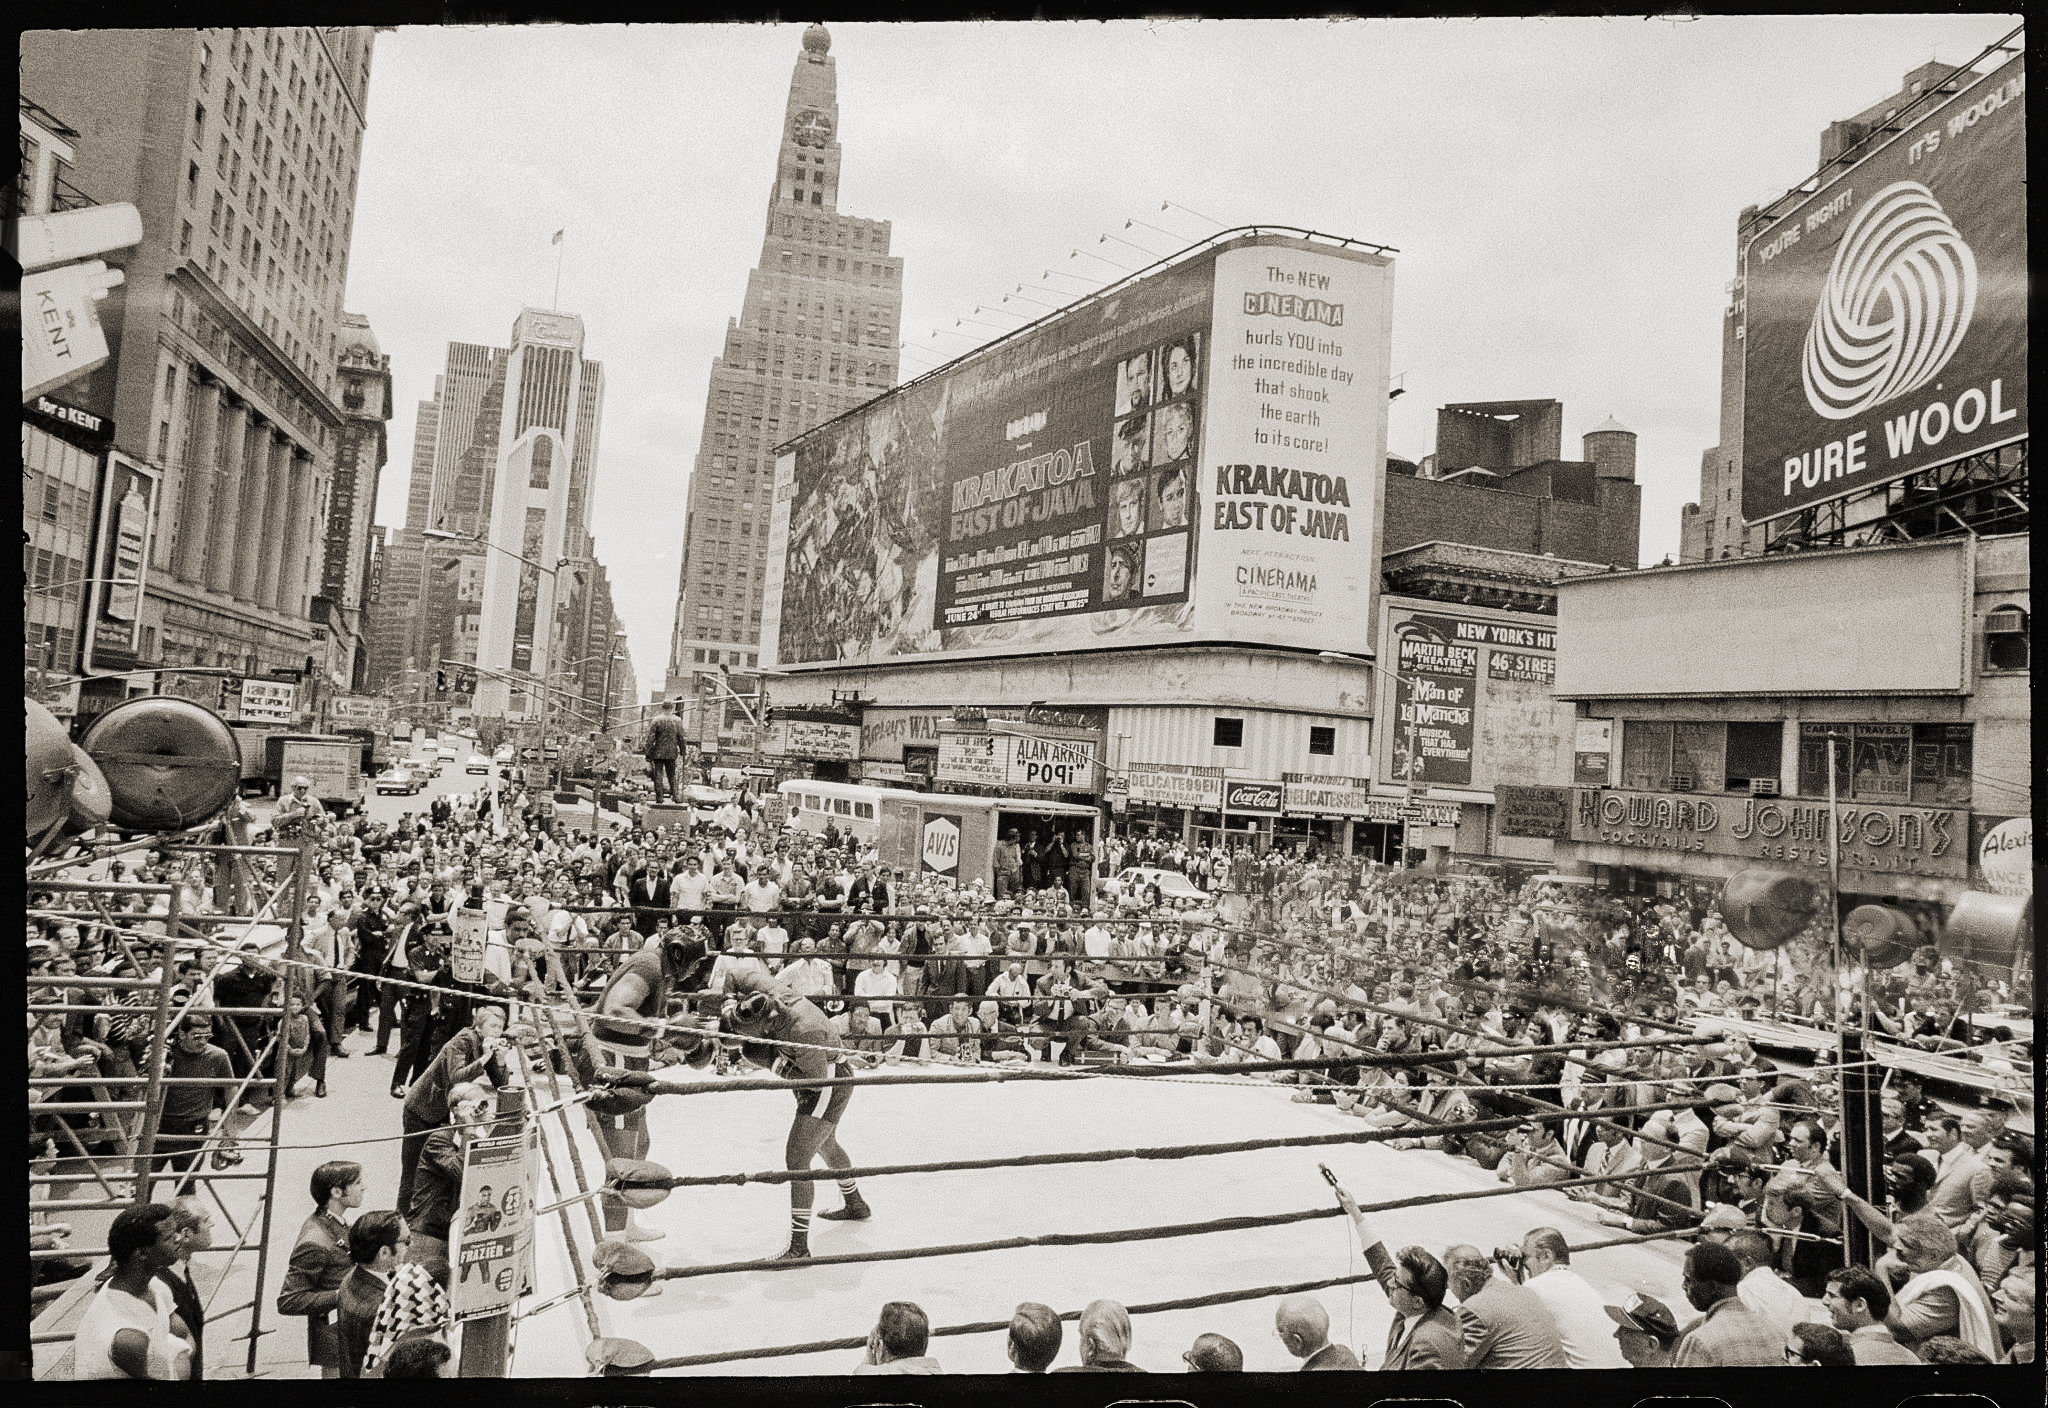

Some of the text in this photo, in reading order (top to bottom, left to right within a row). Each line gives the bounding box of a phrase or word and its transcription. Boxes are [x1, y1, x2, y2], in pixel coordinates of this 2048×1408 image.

[1267, 266, 1331, 290] The NEW
[1244, 291, 1344, 327] CINERAMA
[36, 289, 72, 358] KENT
[1246, 329, 1343, 356] hurls YOU into
[1233, 354, 1353, 385] the incredible day
[1255, 378, 1330, 403] that shook
[58, 407, 66, 419] a
[67, 407, 101, 431] KENT
[1261, 403, 1320, 427] the earth
[1255, 427, 1329, 453] to its core!
[1784, 378, 2017, 496] PURE WOOL
[951, 440, 1096, 514] KRAKATOA
[1216, 463, 1351, 508] KRAKATOA
[949, 479, 1097, 542] EAST OF JAVA
[1214, 501, 1350, 542] EAST OF JAVA
[1236, 566, 1317, 592] CINERAMA
[945, 611, 967, 624] JUNE
[1456, 622, 1488, 641] NEW
[1491, 626, 1534, 647] YORK'S
[1401, 640, 1477, 666] MARTIN BECK
[1416, 654, 1464, 667] THEATRE
[1508, 669, 1547, 682] THEATRE
[1415, 677, 1445, 702] Man
[1415, 703, 1471, 726] Mancha
[909, 715, 941, 740] WAX
[1403, 726, 1451, 740] TE MUSICAL
[1859, 725, 1900, 736] TRAVEL
[1016, 739, 1089, 765] ALAN ARKIN
[1420, 737, 1457, 749] THAT HAS
[1800, 742, 1962, 779] TRAVEL
[1131, 772, 1219, 794] DELICATESSEN
[1229, 787, 1281, 808] Coca-Cola
[1579, 790, 1720, 832] HOWARD
[926, 831, 956, 857] AVIS
[1601, 829, 1705, 851] COCKTAILS
[459, 1244, 504, 1265] FRAZIER
